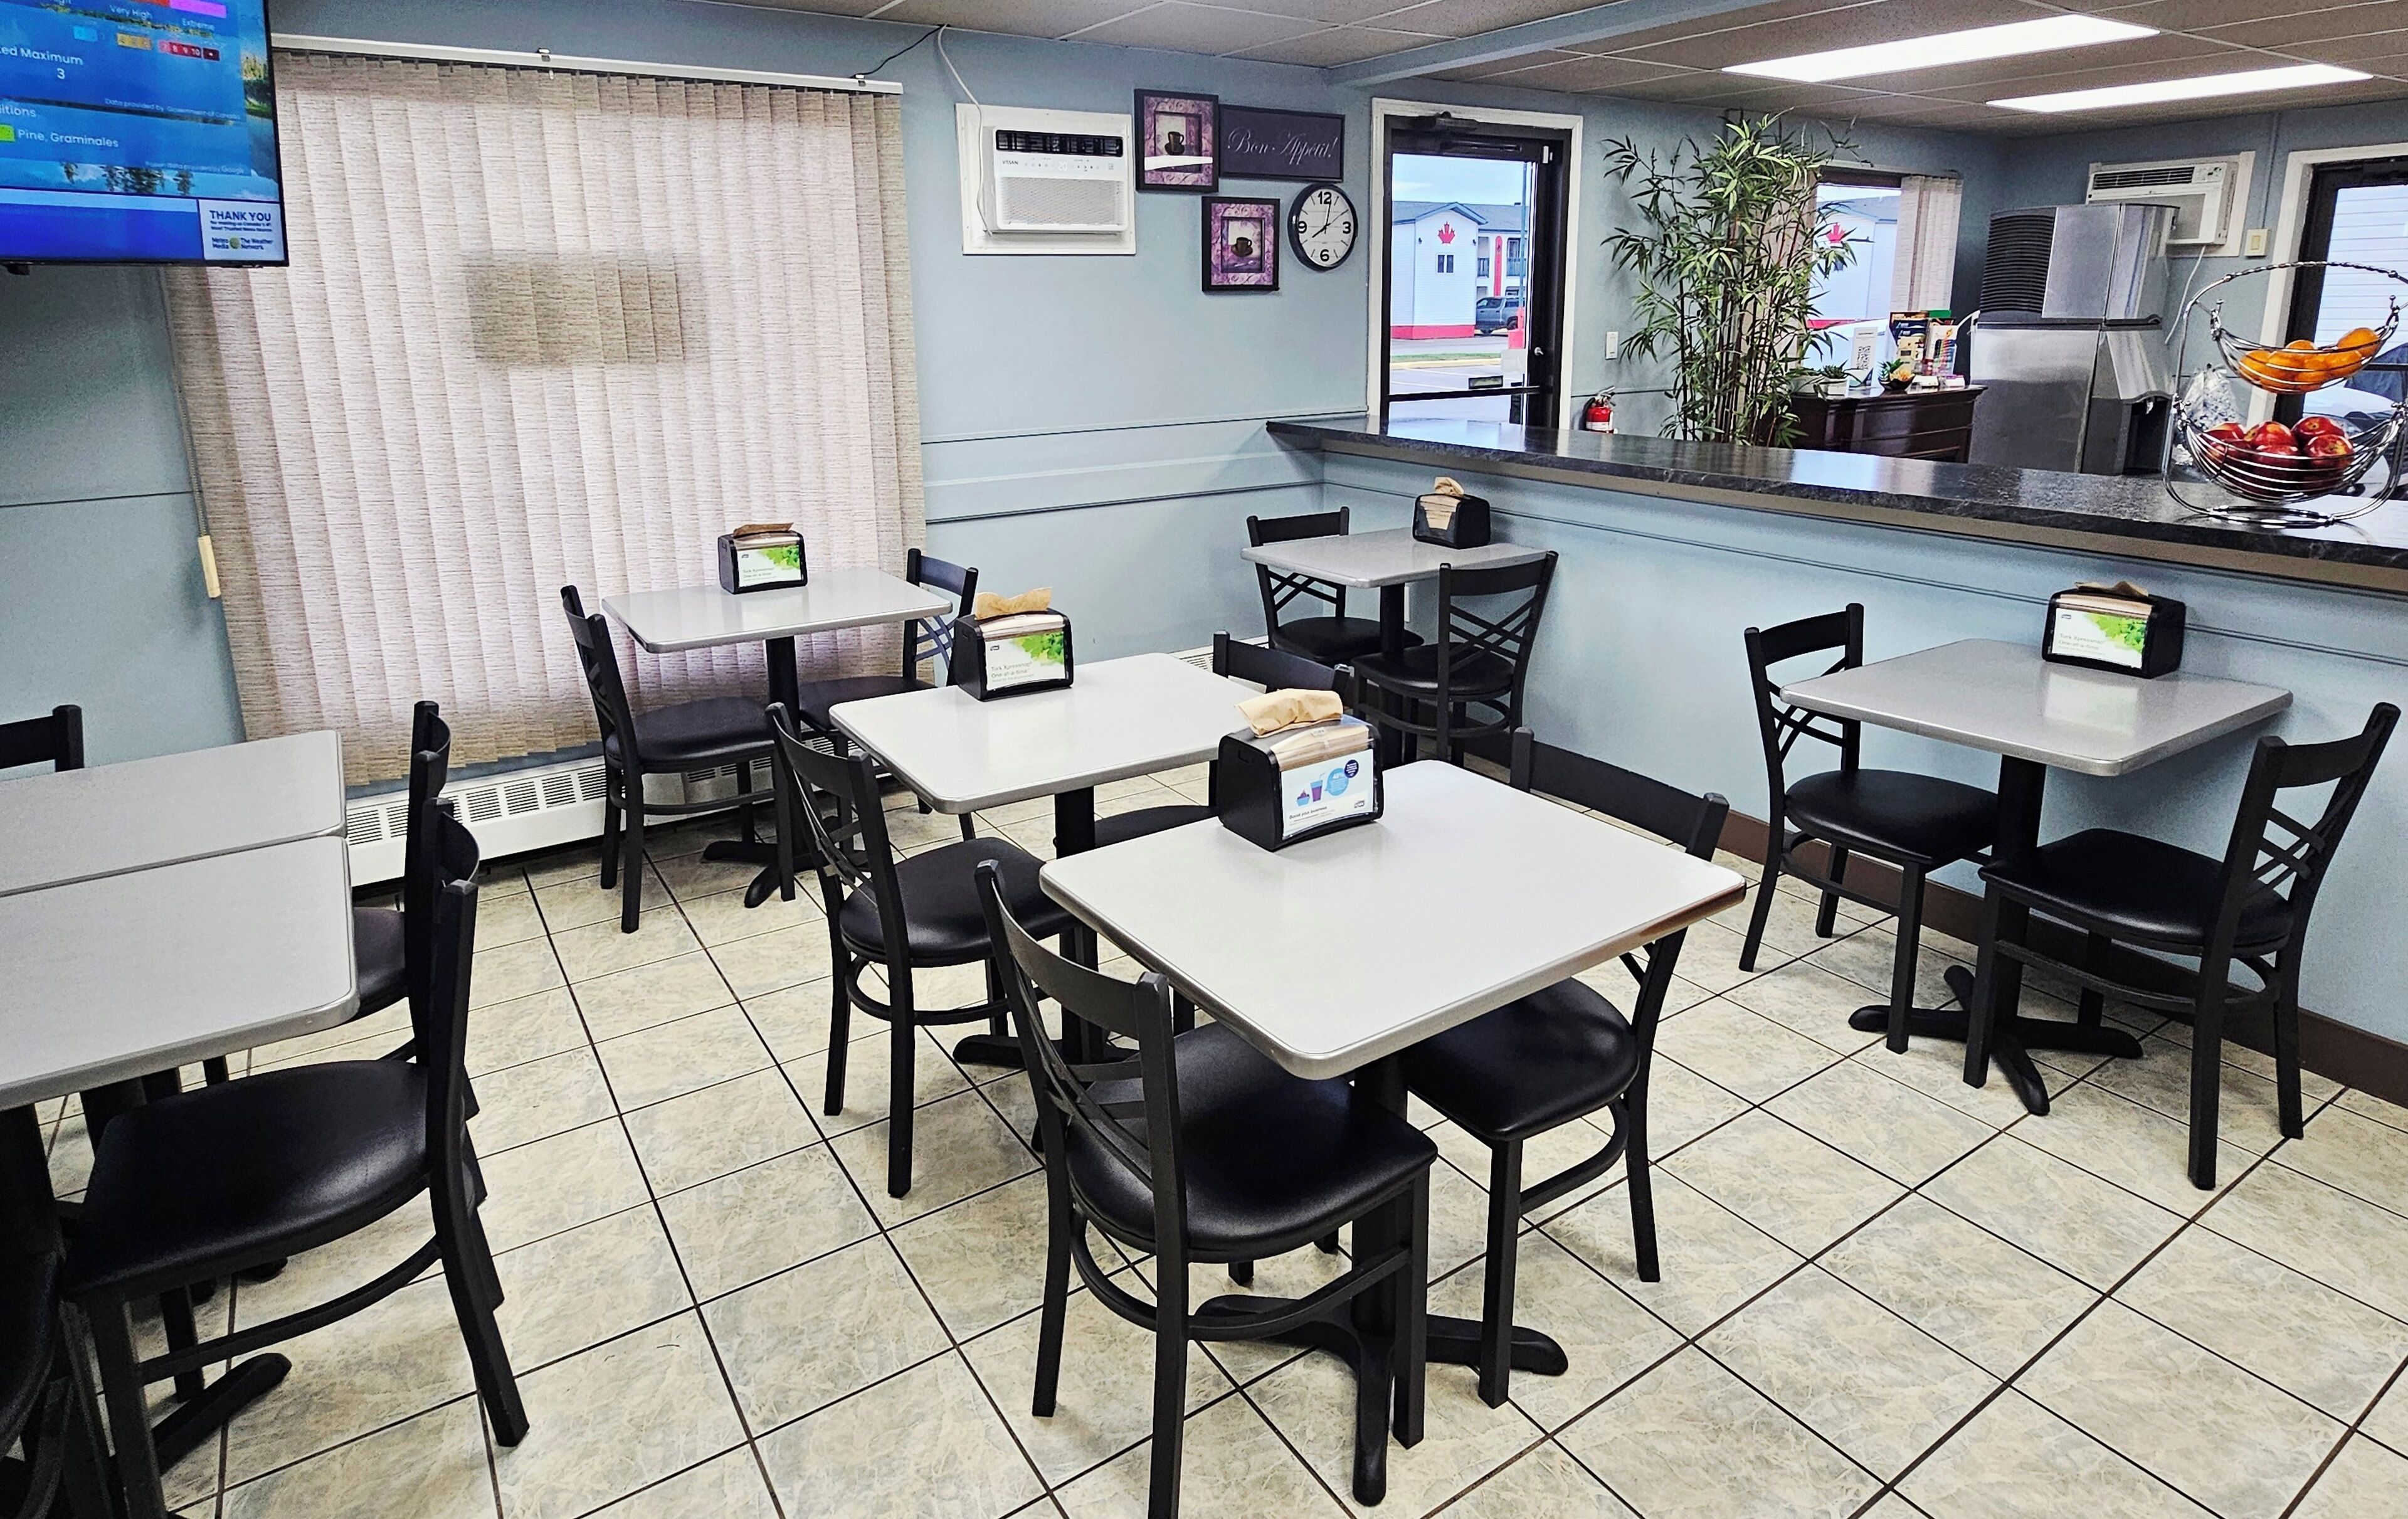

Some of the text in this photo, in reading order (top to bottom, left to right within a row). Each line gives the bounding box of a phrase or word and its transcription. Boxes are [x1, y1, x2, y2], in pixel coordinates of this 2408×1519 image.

[110, 5, 152, 21] Very High
[21, 47, 84, 66] Maximum
[56, 67, 65, 80] 3
[50, 132, 119, 148] Graminales
[1227, 127, 1269, 154] Bon
[1318, 191, 1332, 205] 12
[209, 209, 272, 221] THANK YOU
[1298, 221, 1351, 235] 9 3
[1319, 248, 1329, 262] 6
